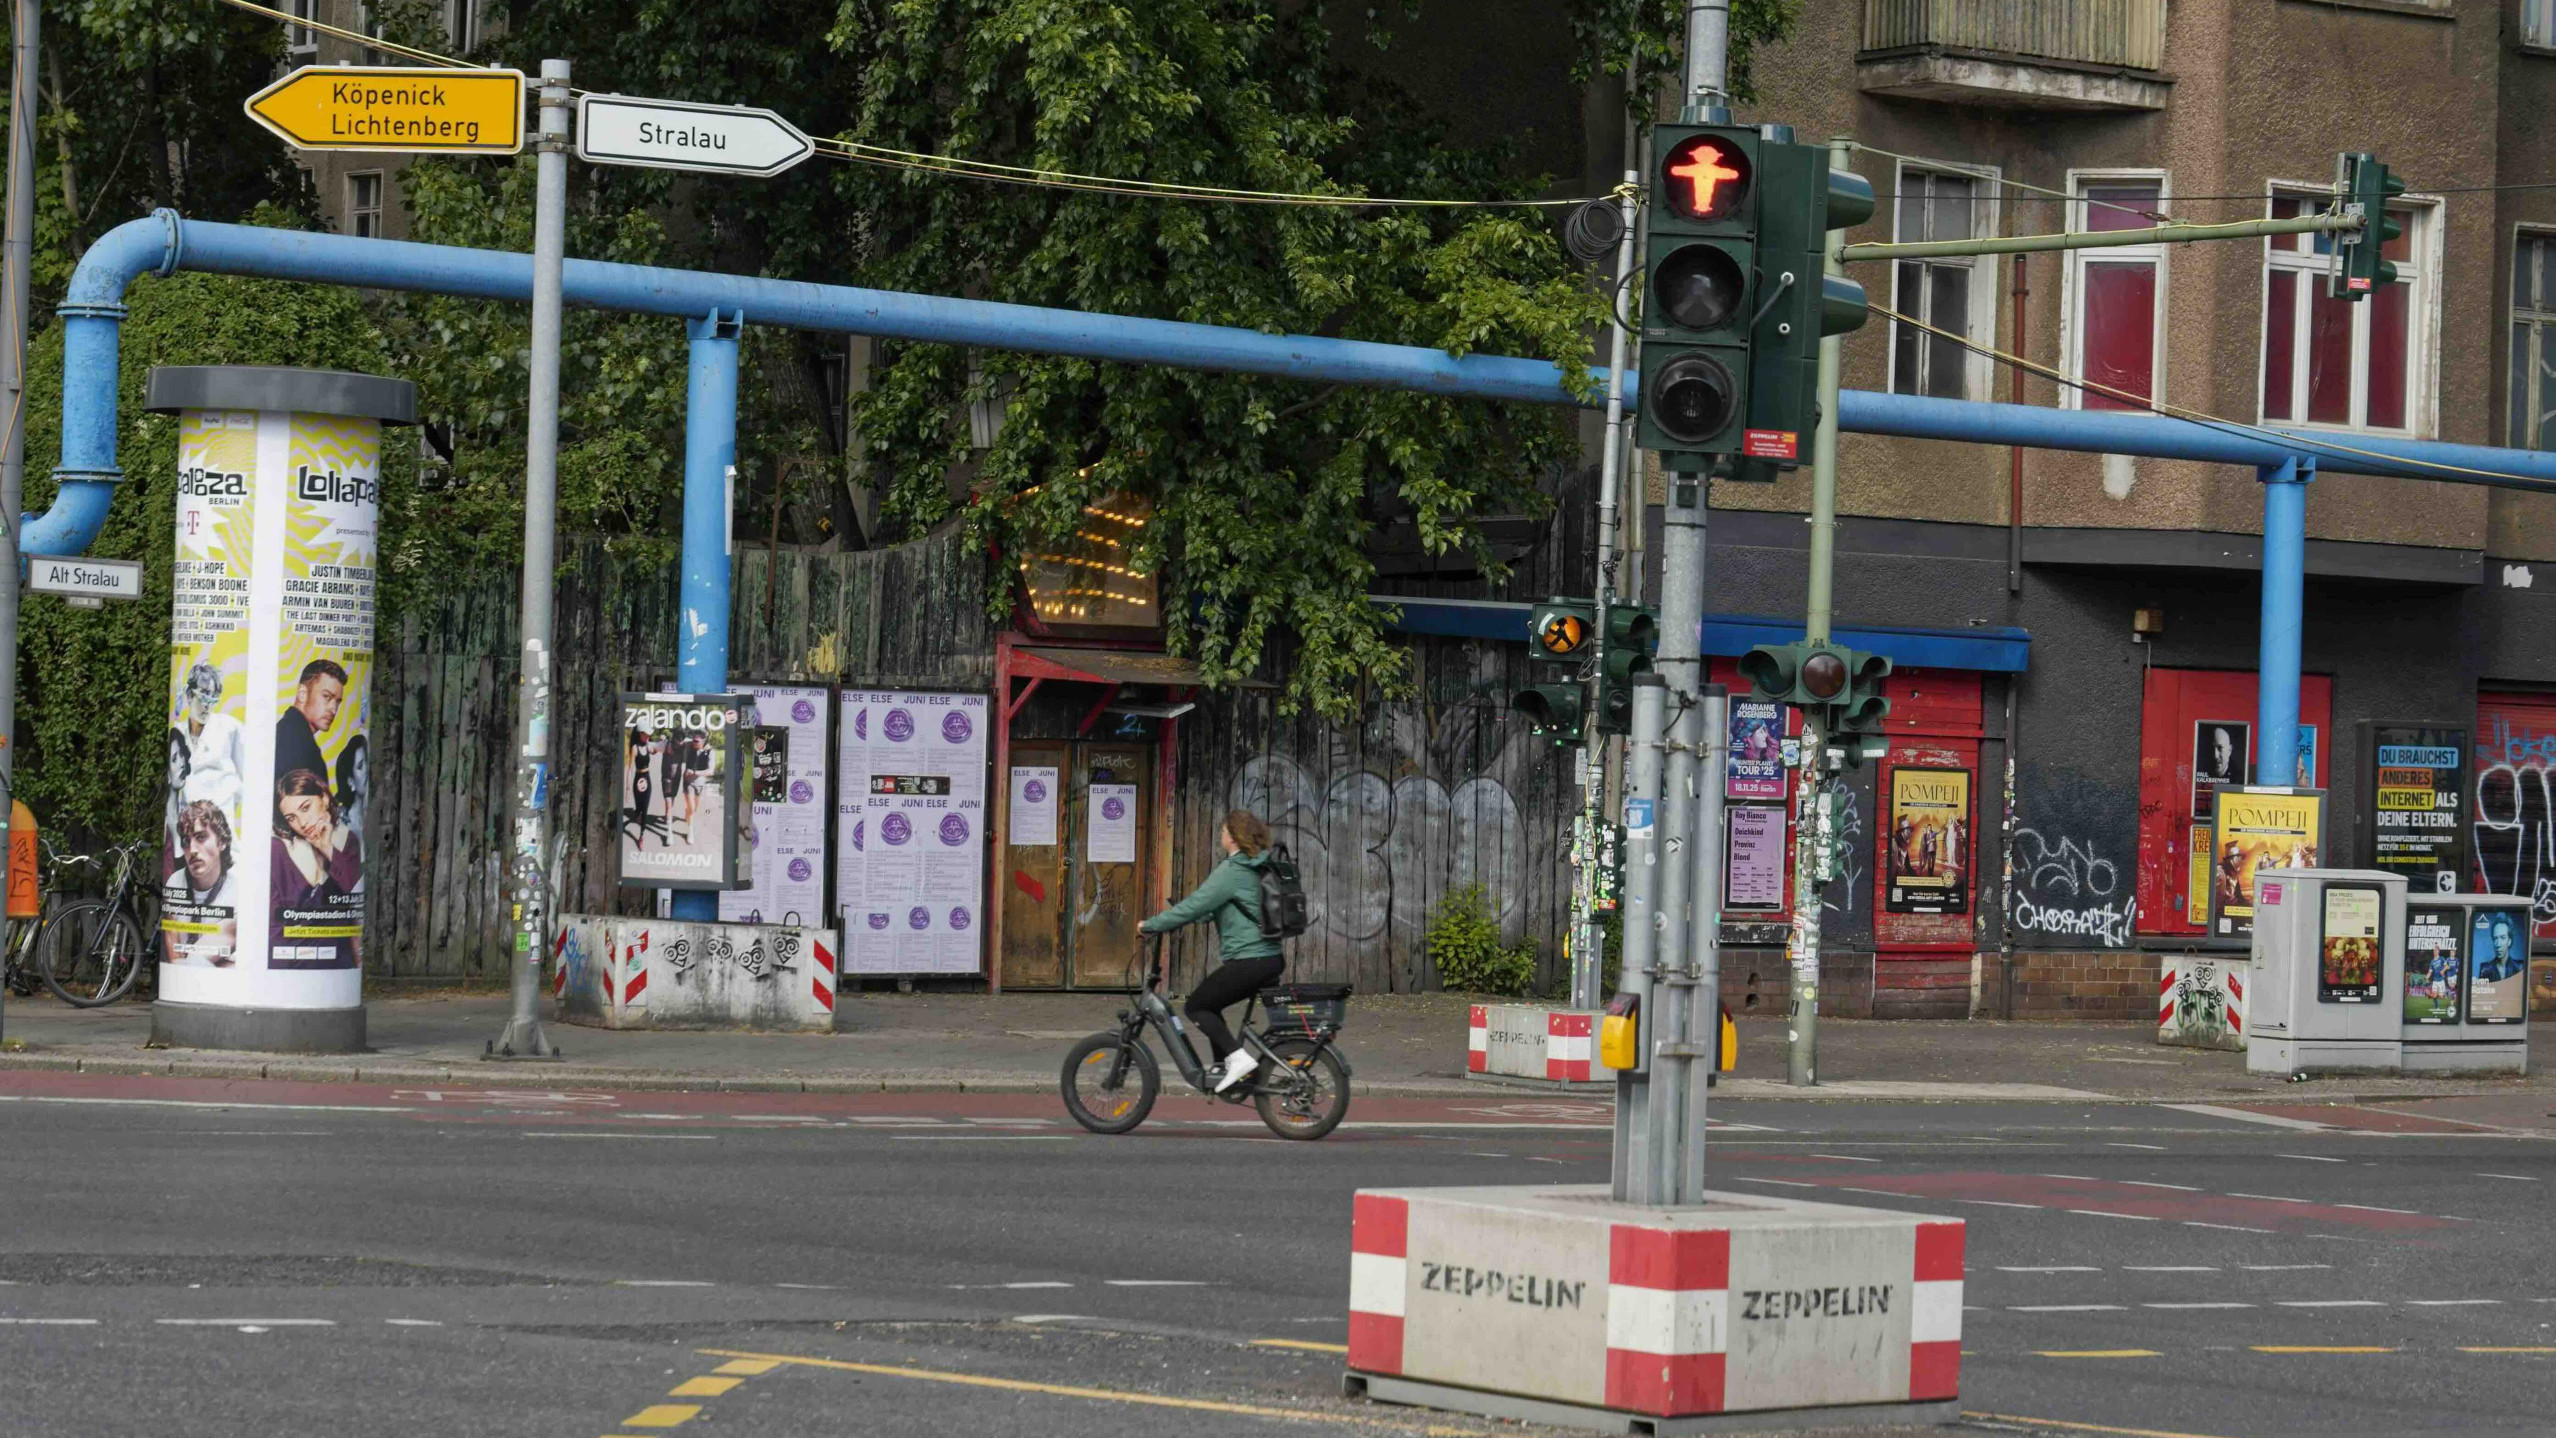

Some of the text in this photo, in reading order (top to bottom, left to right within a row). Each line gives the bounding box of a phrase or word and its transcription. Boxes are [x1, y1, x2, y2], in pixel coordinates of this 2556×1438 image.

[333, 82, 446, 110] Köpenick
[332, 114, 480, 143] Lichtenberg
[639, 122, 727, 150] Stralau
[298, 465, 377, 507] Lollapa
[209, 498, 240, 506] BERLIN
[49, 566, 119, 587] Alt Stralau
[312, 565, 341, 578] JUSTIN
[190, 579, 248, 592] BENSON BOONE
[286, 580, 319, 593] GRACIE
[321, 582, 355, 595] ABRAMS
[208, 595, 229, 605] 3000
[236, 596, 250, 606] IVE
[282, 596, 310, 607] ARMIN
[313, 598, 328, 609] VAN
[286, 611, 299, 620] THE
[842, 693, 864, 703] ELSE
[871, 694, 926, 705] ELSE JUNI
[929, 696, 983, 706] ELSE JUNI
[1739, 702, 1776, 712] MARIANNE
[624, 704, 726, 731] zalando
[1737, 710, 1778, 720] ROSENBERG
[2381, 748, 2456, 765] DU BRAUCHST
[1014, 769, 1055, 777] ELSE JUNI
[1737, 765, 1760, 775] TOUR
[2381, 770, 2431, 785] ANDERES
[1092, 787, 1134, 795] ELSE JUNI
[1900, 783, 1960, 804] POMPEJI
[868, 798, 923, 808] ELSE JUNI
[926, 799, 980, 809] ELSE JUNI
[2380, 790, 2458, 808] INTERNET ALS
[753, 806, 772, 815] UNI
[840, 805, 862, 814] ELSE
[1735, 811, 1767, 821] Roy Bianco
[2229, 808, 2307, 830] POMPEJI
[2377, 811, 2458, 828] DEINE ELTERN.
[1734, 827, 1764, 836] Deichkind
[1734, 840, 1756, 849] Provinz
[777, 847, 821, 855] ELSE JUNI
[1733, 852, 1751, 861] Blond
[200, 907, 227, 917] Berlin
[283, 909, 346, 921] Olympiastadion
[1421, 1262, 1583, 1310] ZEPPELIN
[1741, 1284, 1891, 1320] ZEPPELIN
